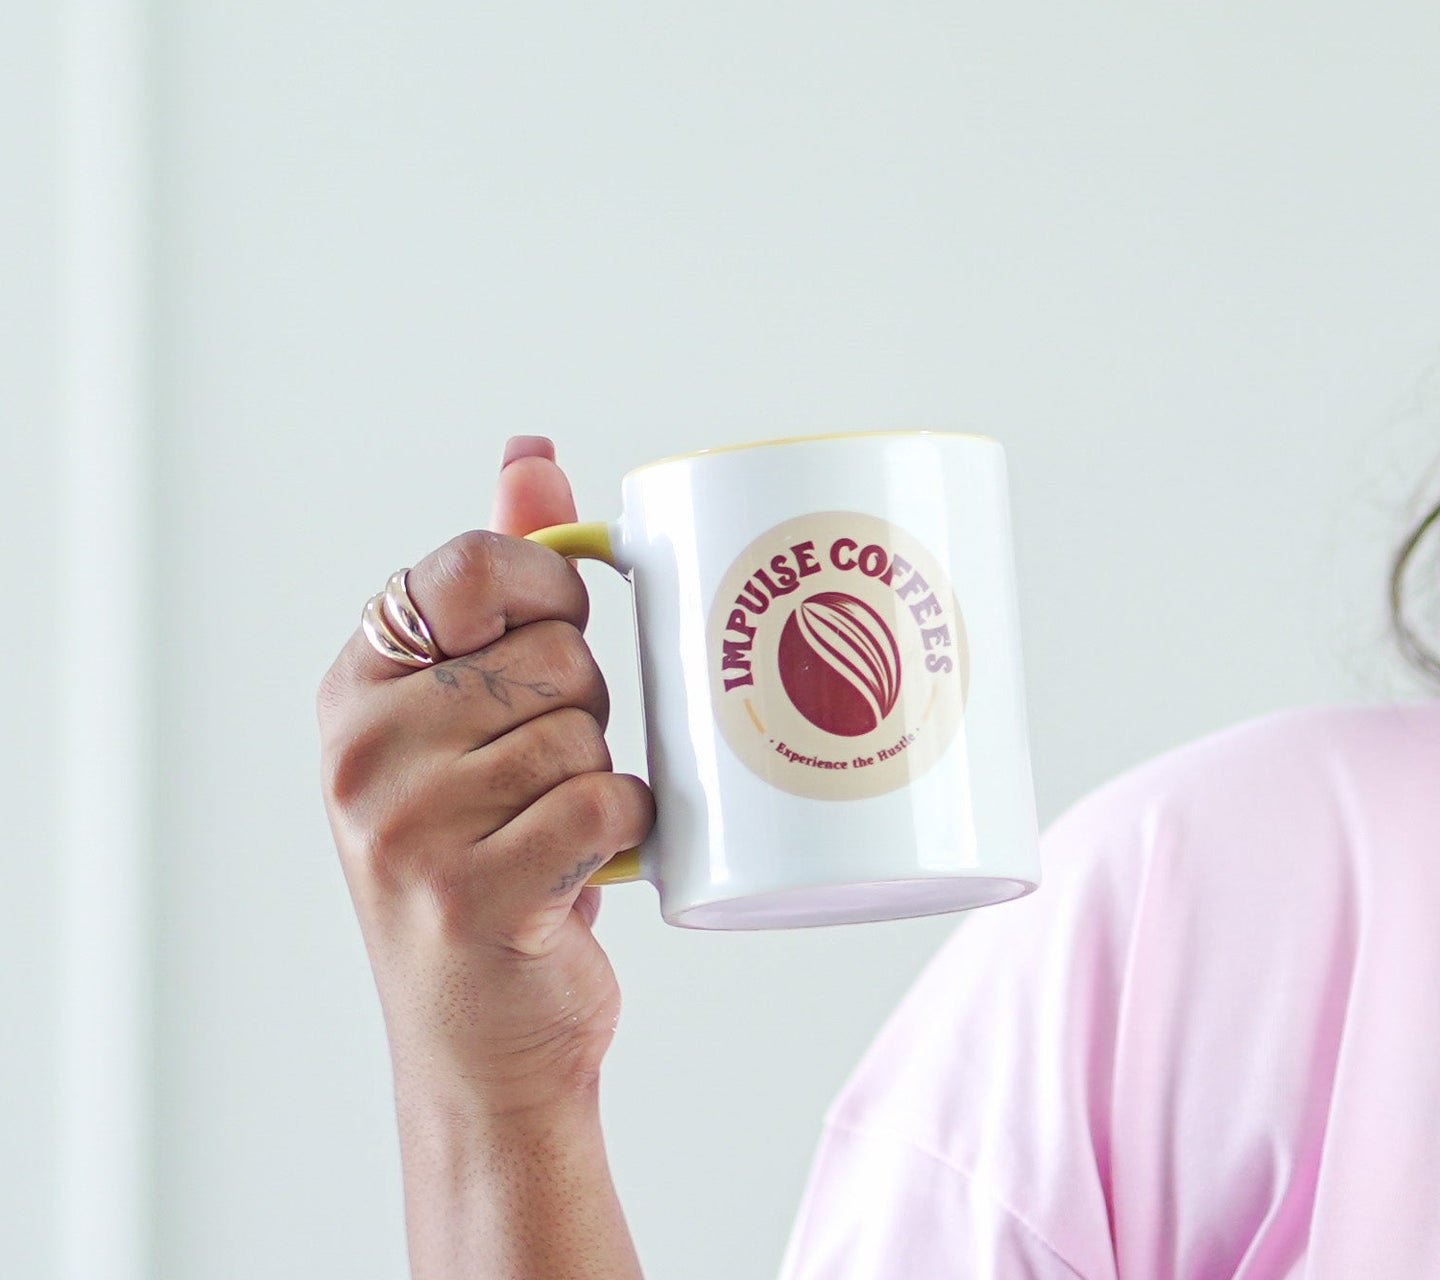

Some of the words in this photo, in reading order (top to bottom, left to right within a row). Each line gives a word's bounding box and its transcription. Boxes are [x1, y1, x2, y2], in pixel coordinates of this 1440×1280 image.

[720, 540, 822, 693] IMPULSE
[829, 537, 953, 675] COFFEES
[774, 741, 848, 770] Experience
[852, 757, 874, 770] the
[877, 733, 915, 762] Hustle
